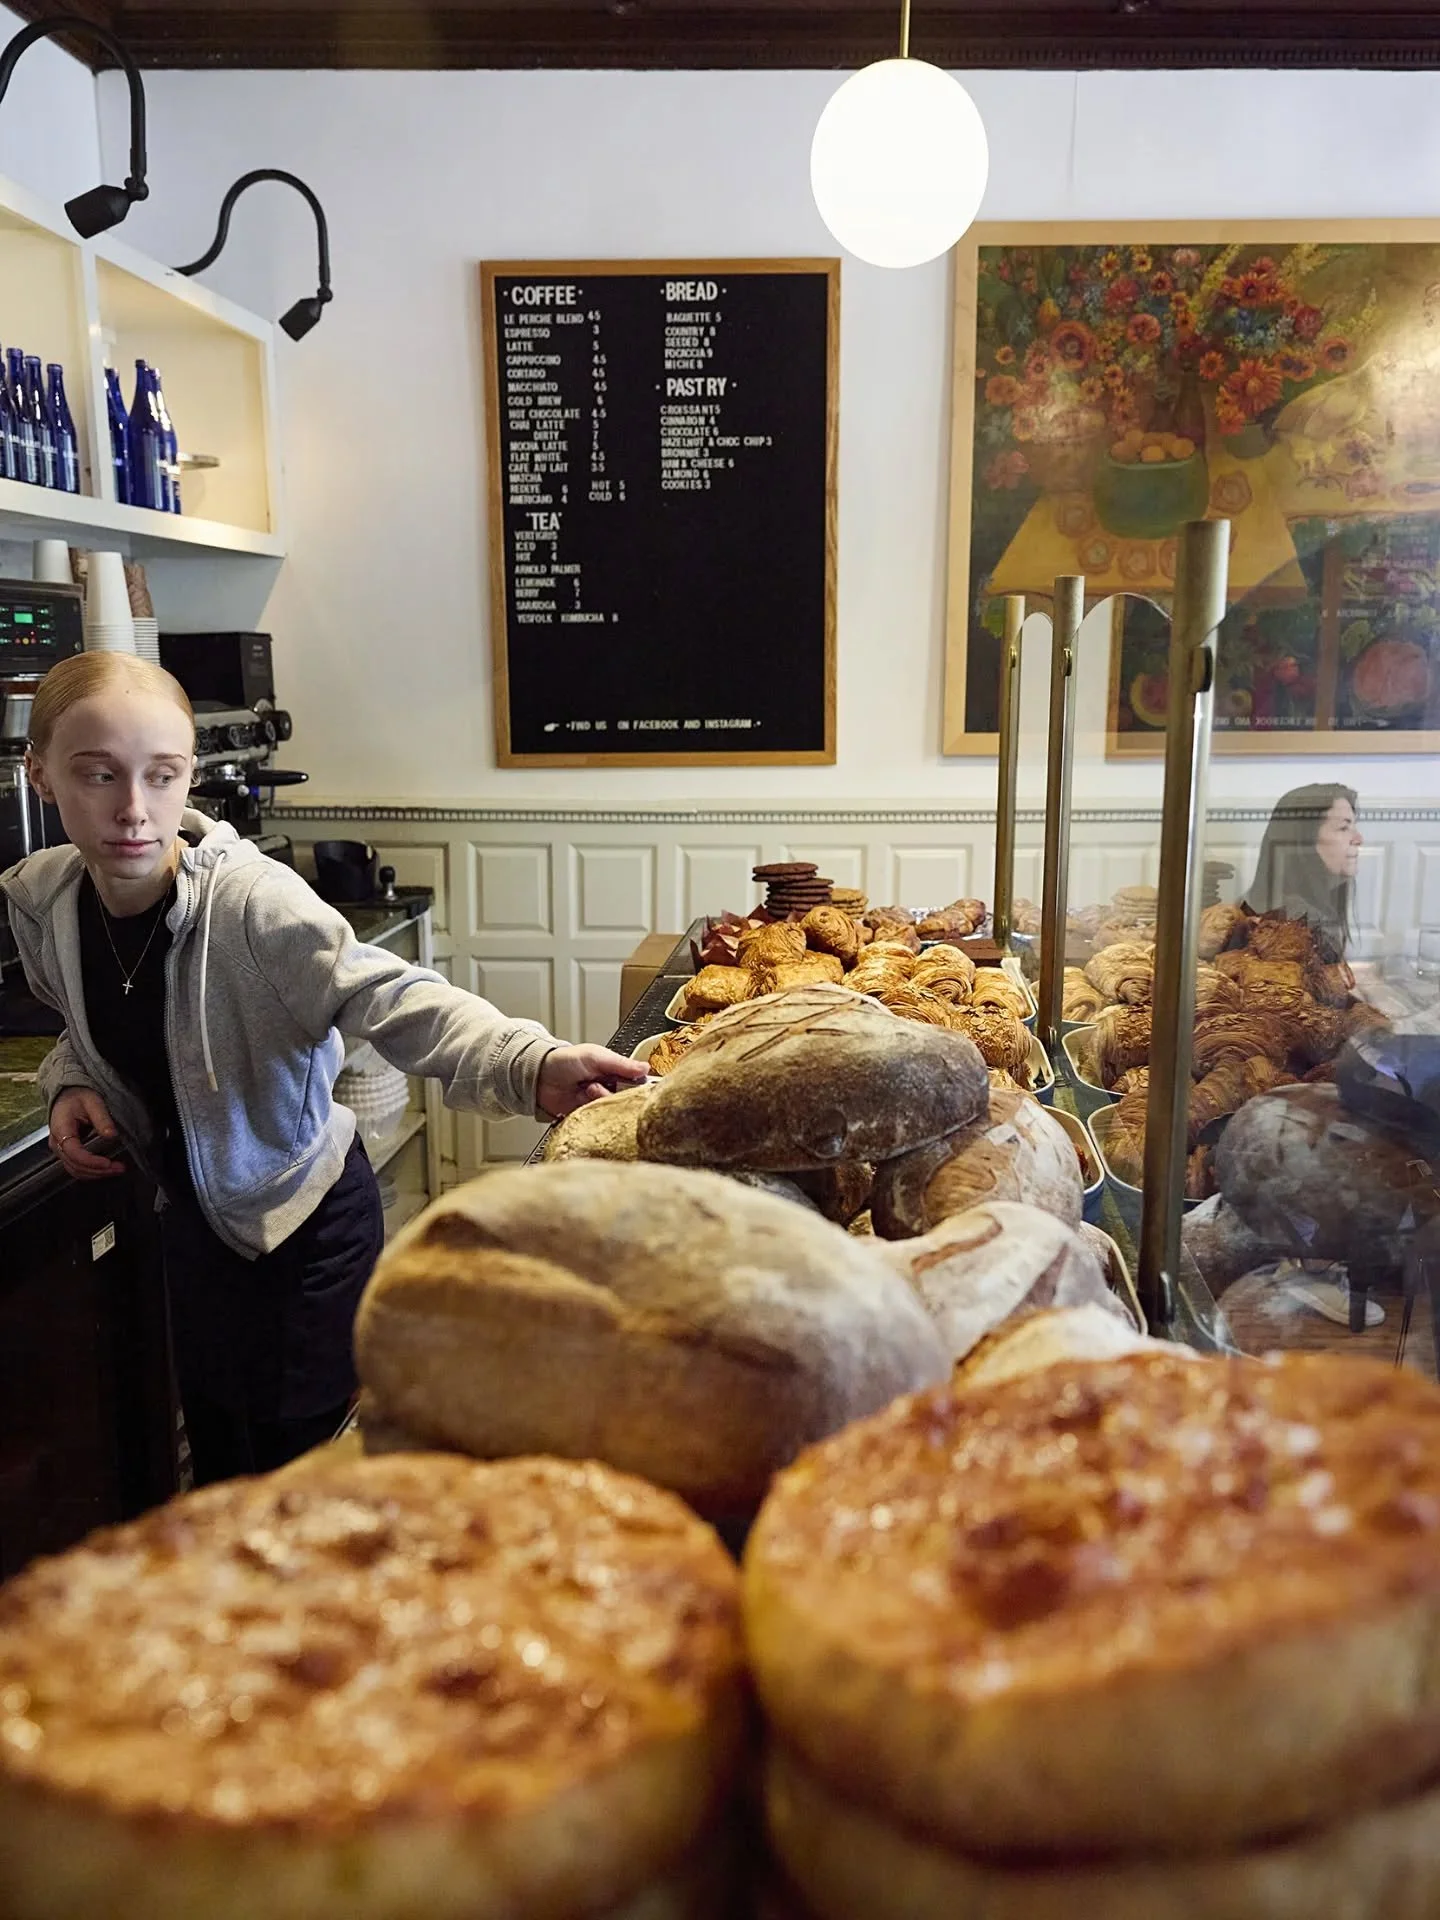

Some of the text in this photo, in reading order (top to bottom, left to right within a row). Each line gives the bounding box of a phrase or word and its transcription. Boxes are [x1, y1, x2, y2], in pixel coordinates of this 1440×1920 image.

[512, 286, 576, 304] COFFEE
[666, 282, 717, 300] BREAD
[504, 314, 514, 324] LE
[519, 314, 551, 324] PERCHE
[556, 314, 584, 323] BLEND
[667, 312, 721, 322] BAGUETTE 5
[505, 325, 599, 338] ESPRESSO 3
[665, 327, 704, 336] COUNTRY
[507, 341, 599, 351] LATTE 5
[666, 337, 699, 347] SEEDED
[665, 348, 713, 358] FOCACCIA 9
[506, 356, 561, 365] CAPPUCCINO
[665, 360, 694, 369] MICHE
[507, 369, 546, 378] CORTADO
[508, 383, 558, 392] MACCHIATO
[508, 396, 532, 406] COLD
[538, 396, 561, 405] BREW
[509, 410, 525, 418] HOT
[529, 409, 579, 418] CHOCOLATE
[660, 405, 720, 414] CROISSANT 5
[709, 416, 715, 424] 4
[510, 420, 599, 430] CHAI LATTE 5
[534, 431, 598, 441] DIRTY 7
[661, 427, 709, 436] CHOCOLATE
[510, 441, 598, 450] MOCHA LATTE 5
[662, 438, 704, 447] HAZELNUT
[716, 437, 739, 446] CHOC
[744, 437, 765, 445] CHIP
[766, 436, 772, 445] 3
[511, 453, 529, 461] FLAT
[534, 453, 560, 461] WHITE
[661, 448, 709, 457] BROWNIE 3
[509, 463, 529, 473] CAFE
[534, 464, 546, 472] AU
[550, 463, 568, 472] LAIT
[690, 459, 724, 468] CHEESE
[510, 474, 542, 482] MATCHA
[662, 470, 699, 478] ALMOND
[592, 480, 625, 490] HOT 5
[662, 480, 710, 489] COOKIES 3
[561, 495, 567, 503] 4
[589, 492, 612, 501] COLD
[530, 513, 560, 530] TEA
[516, 542, 557, 551] ICED 3
[515, 565, 580, 574] ARNOLD PALMER
[576, 588, 580, 596] 7
[634, 720, 678, 729] FACEBOOK
[684, 720, 700, 728] AND
